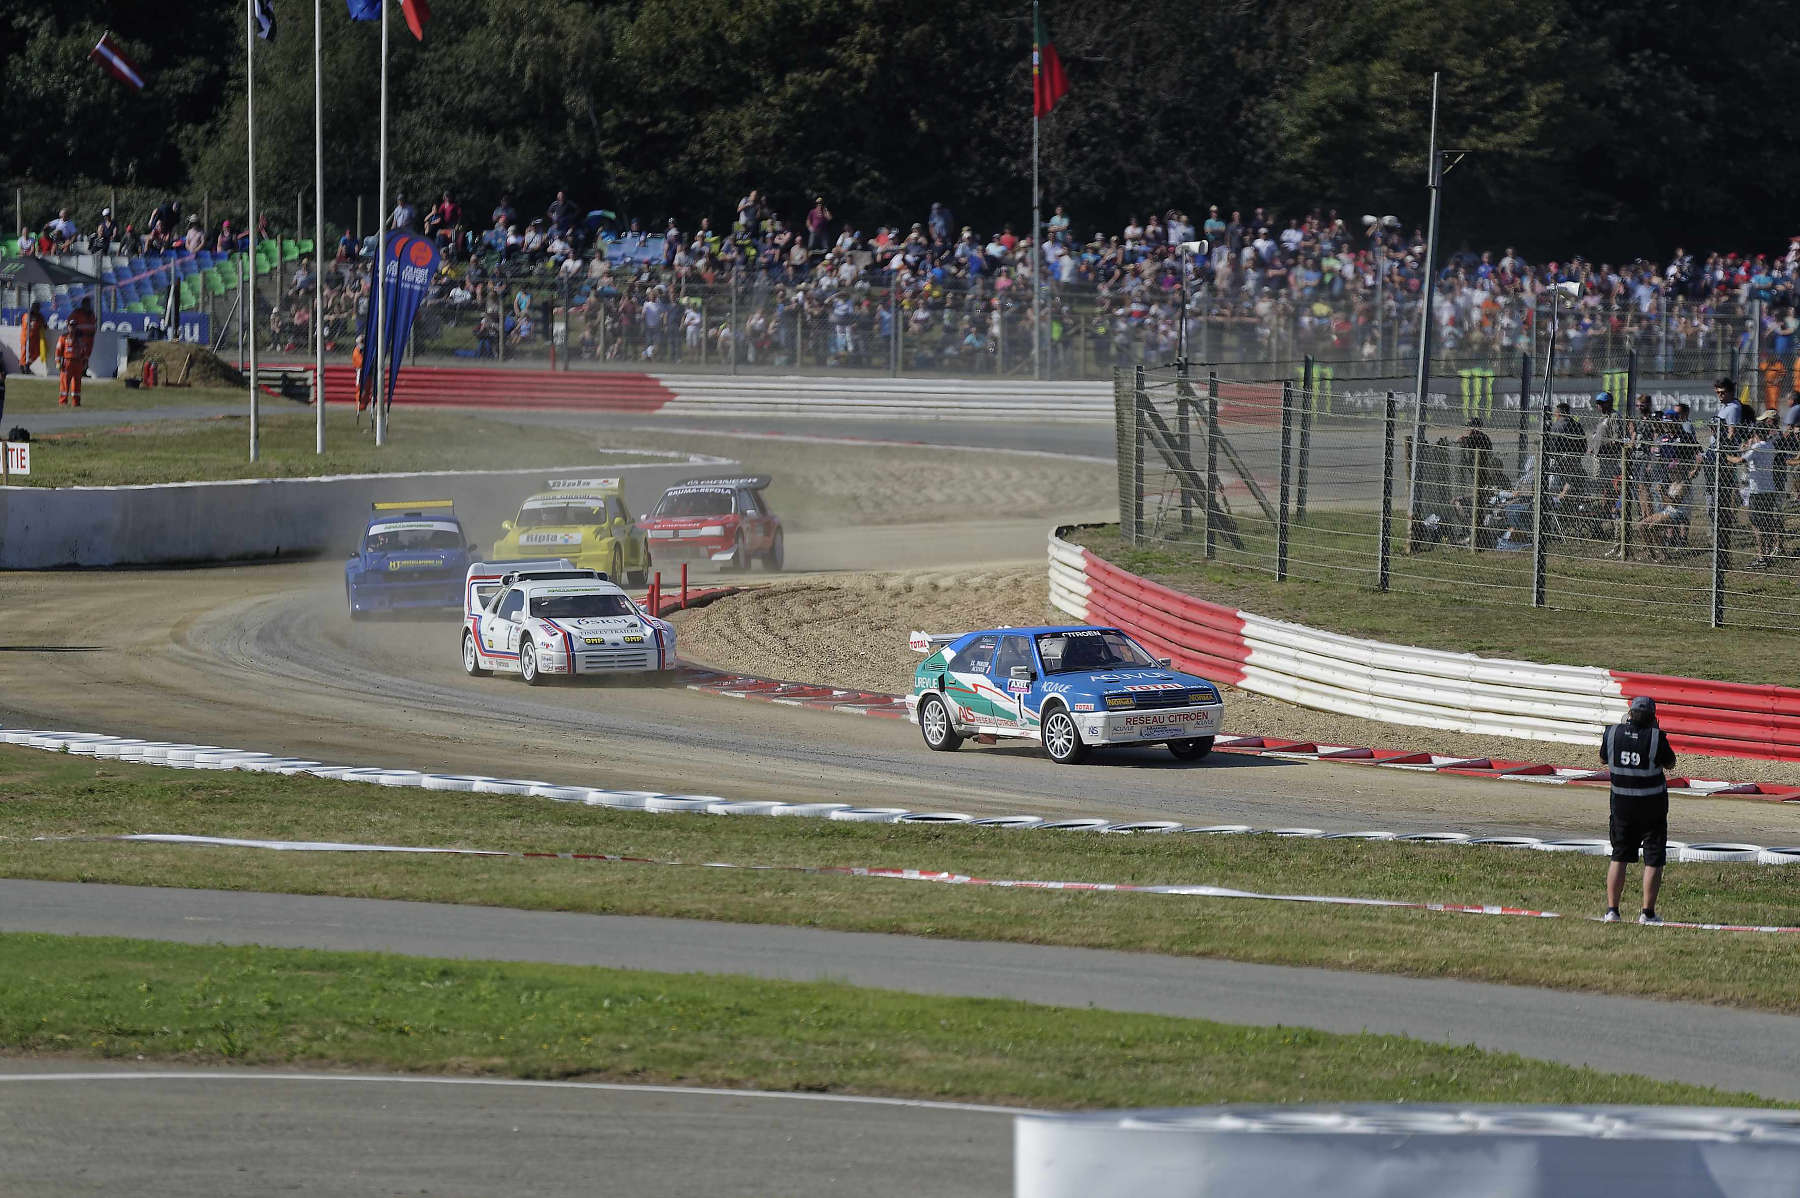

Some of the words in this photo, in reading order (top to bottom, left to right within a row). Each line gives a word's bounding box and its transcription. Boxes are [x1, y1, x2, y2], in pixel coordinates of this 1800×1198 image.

[585, 637, 603, 645] OMP
[910, 640, 927, 649] TOTAL
[1010, 680, 1028, 688] AXEL
[1126, 683, 1183, 692] TOTAL
[1017, 693, 1024, 719] 1
[1125, 715, 1165, 726] RESEAU
[1620, 750, 1641, 767] 59
